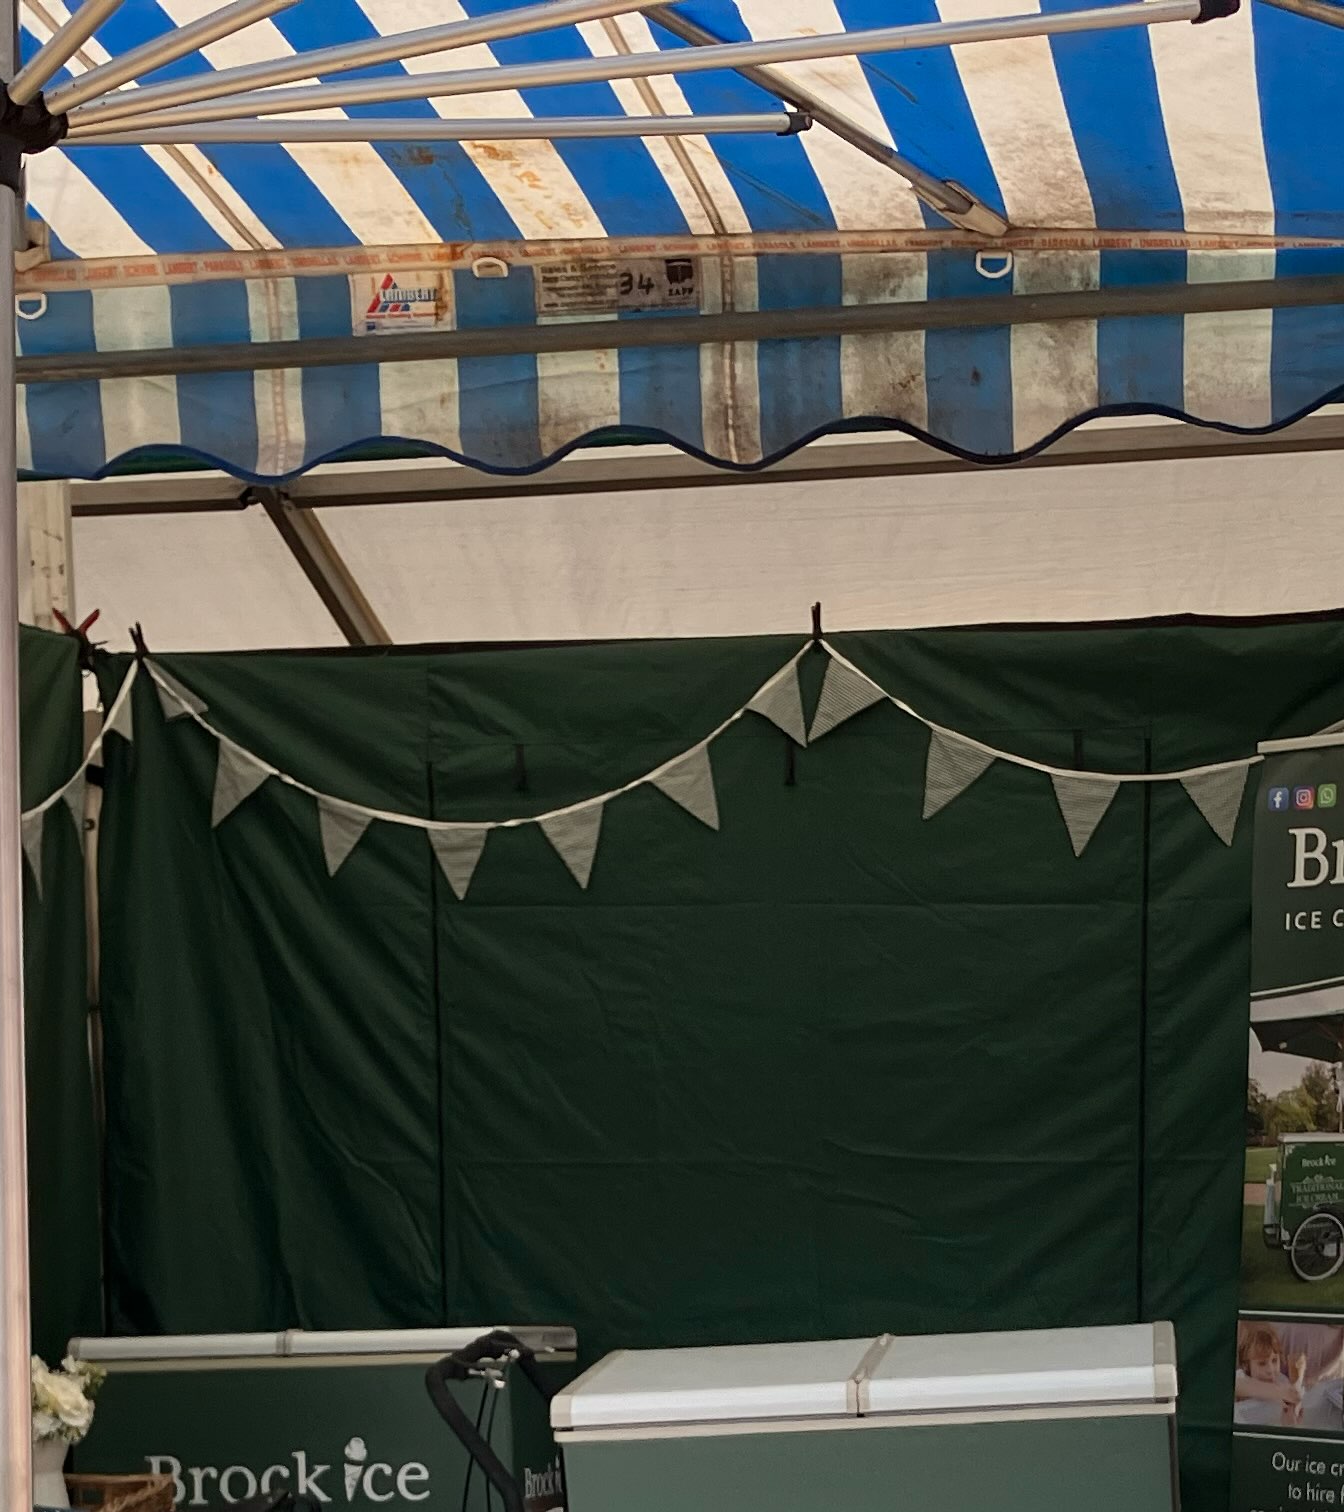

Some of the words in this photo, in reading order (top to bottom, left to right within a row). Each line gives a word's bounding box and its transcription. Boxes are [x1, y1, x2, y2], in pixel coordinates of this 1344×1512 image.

[619, 272, 655, 295] 34
[1285, 911, 1322, 931] ICE
[1271, 1452, 1301, 1472] Our
[1305, 1454, 1326, 1475] ice
[144, 1450, 333, 1505] Brock
[1288, 1483, 1302, 1500] to
[1306, 1482, 1335, 1505] hire
